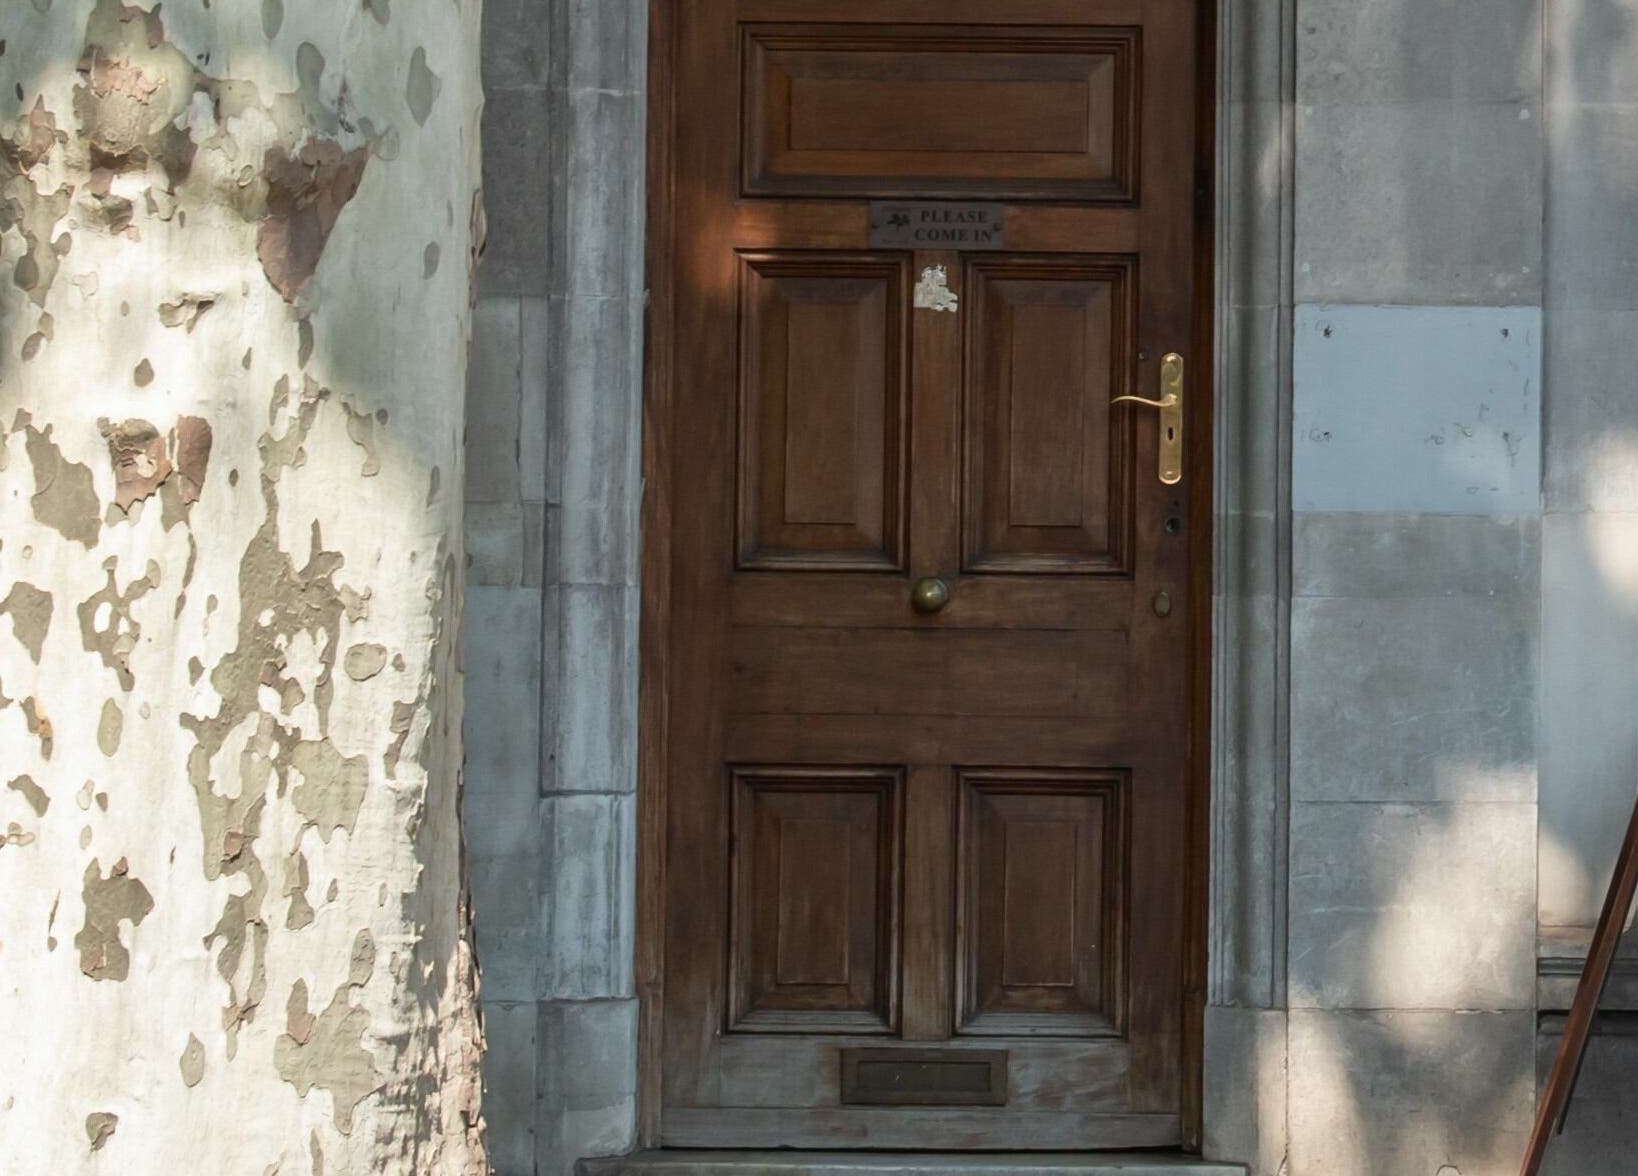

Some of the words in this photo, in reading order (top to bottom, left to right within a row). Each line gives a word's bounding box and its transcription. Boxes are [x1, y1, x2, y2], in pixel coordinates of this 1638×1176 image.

[920, 210, 988, 223] PLEASE
[914, 228, 968, 242] COME
[974, 229, 993, 242] IN
